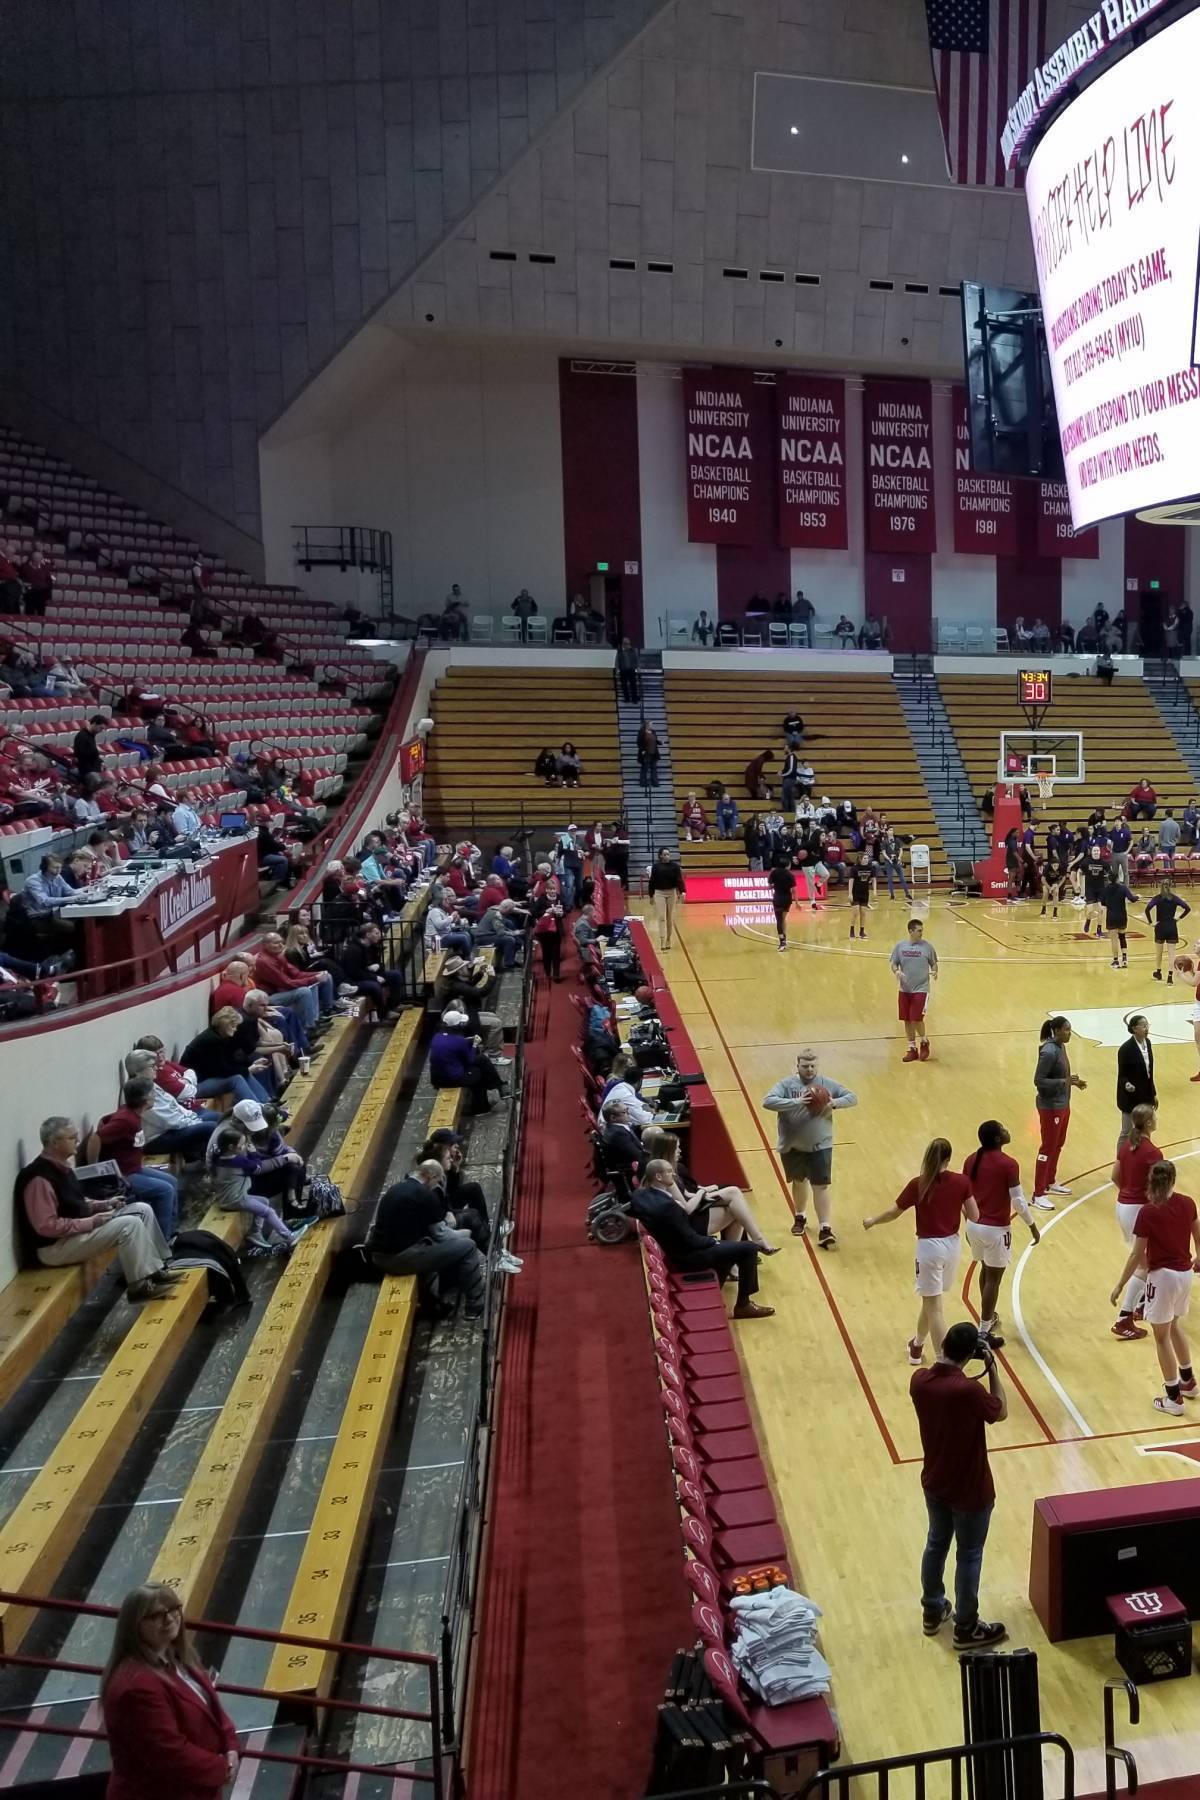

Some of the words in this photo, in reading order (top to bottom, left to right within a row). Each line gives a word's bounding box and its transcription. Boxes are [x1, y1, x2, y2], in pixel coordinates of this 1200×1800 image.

[1034, 12, 1105, 107] ASSEMBLY
[1101, 0, 1162, 41] HAL
[1074, 136, 1115, 246] HELP
[1124, 99, 1176, 210] LINE
[1102, 263, 1138, 310] TODAY'S
[1138, 247, 1172, 290] GAME,
[1115, 312, 1145, 361] (MYIU)
[695, 391, 742, 408] INDIANA
[789, 396, 834, 414] INDIANA
[1096, 394, 1129, 433] RESPOND
[1128, 389, 1140, 421] TO
[1140, 379, 1167, 414] YOUR
[689, 409, 750, 428] UNIVERSITY
[878, 403, 923, 420] INDIANA
[782, 415, 840, 434] UNIVERSITY
[871, 422, 929, 439] UNIVERSITY
[688, 433, 753, 460] NCAA
[781, 438, 843, 465] NCAA
[870, 444, 931, 469] NCAA
[1098, 449, 1114, 481] WITH
[1112, 442, 1133, 476] YOUR
[1132, 432, 1164, 469] NEEDS.
[690, 464, 752, 483] BASKETBALL
[783, 470, 842, 488] BASKETBALL
[872, 475, 931, 492] BASKETBALL
[957, 478, 1013, 495] BASKETBALL
[693, 484, 749, 501] CHAMPIONS
[786, 489, 840, 506] CHAMPIONS
[874, 493, 928, 510] CHAMPIONS
[960, 497, 1010, 513] CHAMPIONS
[709, 508, 737, 523] 1940
[800, 512, 826, 527] 1953
[890, 517, 915, 531] 1976
[975, 519, 997, 535] 1981
[1021, 672, 1048, 682] 43:34
[1026, 683, 1045, 700] 30
[724, 877, 753, 887] INDIANA
[323, 1530, 341, 1541] 33
[311, 1568, 329, 1580] 34
[1124, 1591, 1163, 1615] IU
[298, 1612, 318, 1625] 35
[288, 1653, 308, 1668] 36
